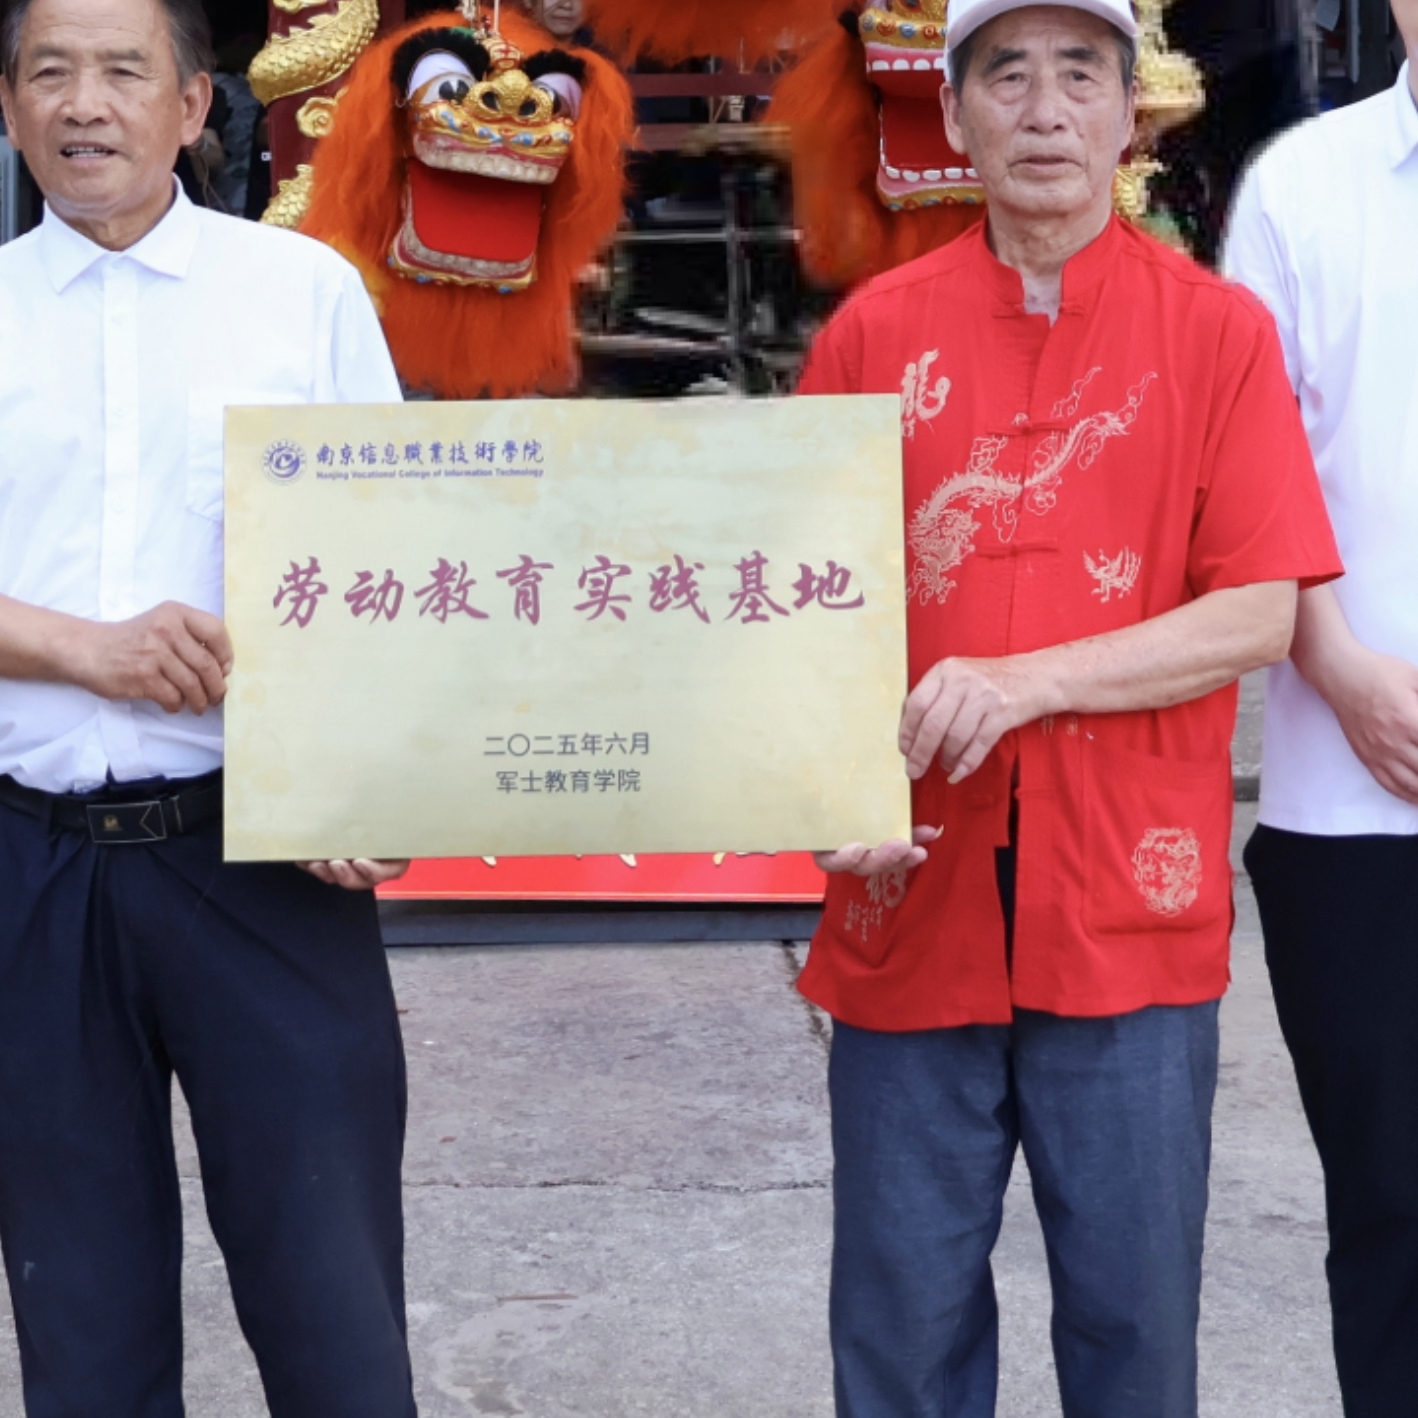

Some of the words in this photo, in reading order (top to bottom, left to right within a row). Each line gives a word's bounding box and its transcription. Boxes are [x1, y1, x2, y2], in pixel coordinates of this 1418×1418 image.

[351, 469, 396, 479] Vocational
[398, 468, 431, 480] College
[433, 468, 442, 477] of
[444, 468, 493, 477] Information
[495, 467, 544, 478] Technology
[273, 550, 865, 628] 劳动教育实践基地
[496, 768, 641, 794] 军士教育学院
